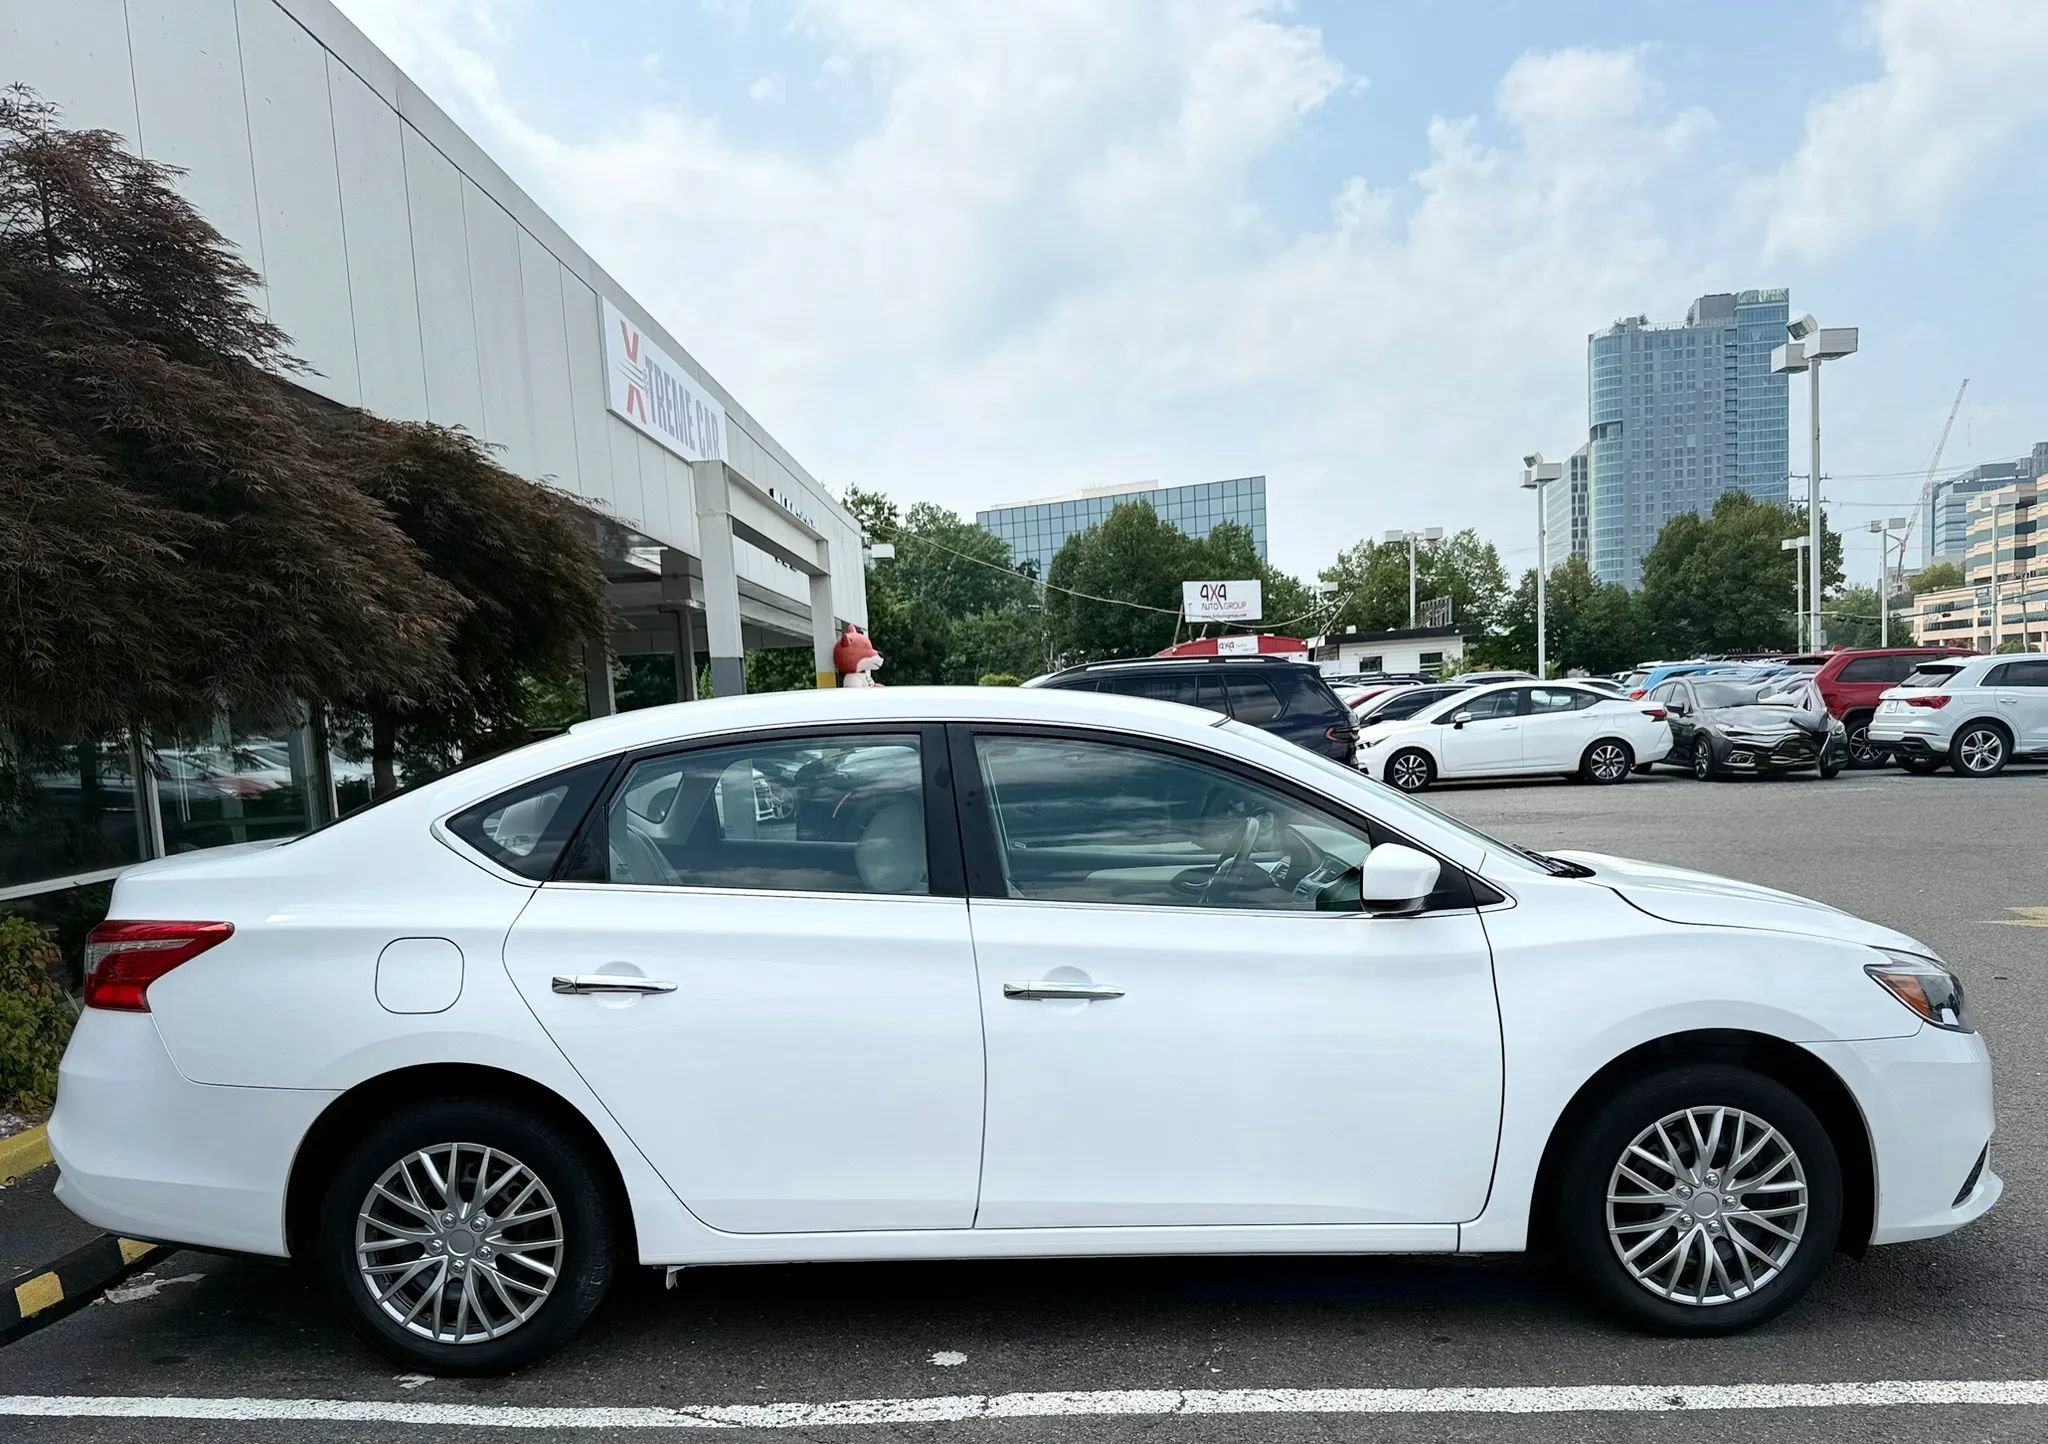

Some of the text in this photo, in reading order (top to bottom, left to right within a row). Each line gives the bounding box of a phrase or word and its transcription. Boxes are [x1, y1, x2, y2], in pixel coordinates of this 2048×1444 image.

[696, 400, 721, 461] CAR
[1201, 601, 1247, 611] AUTO GROUP
